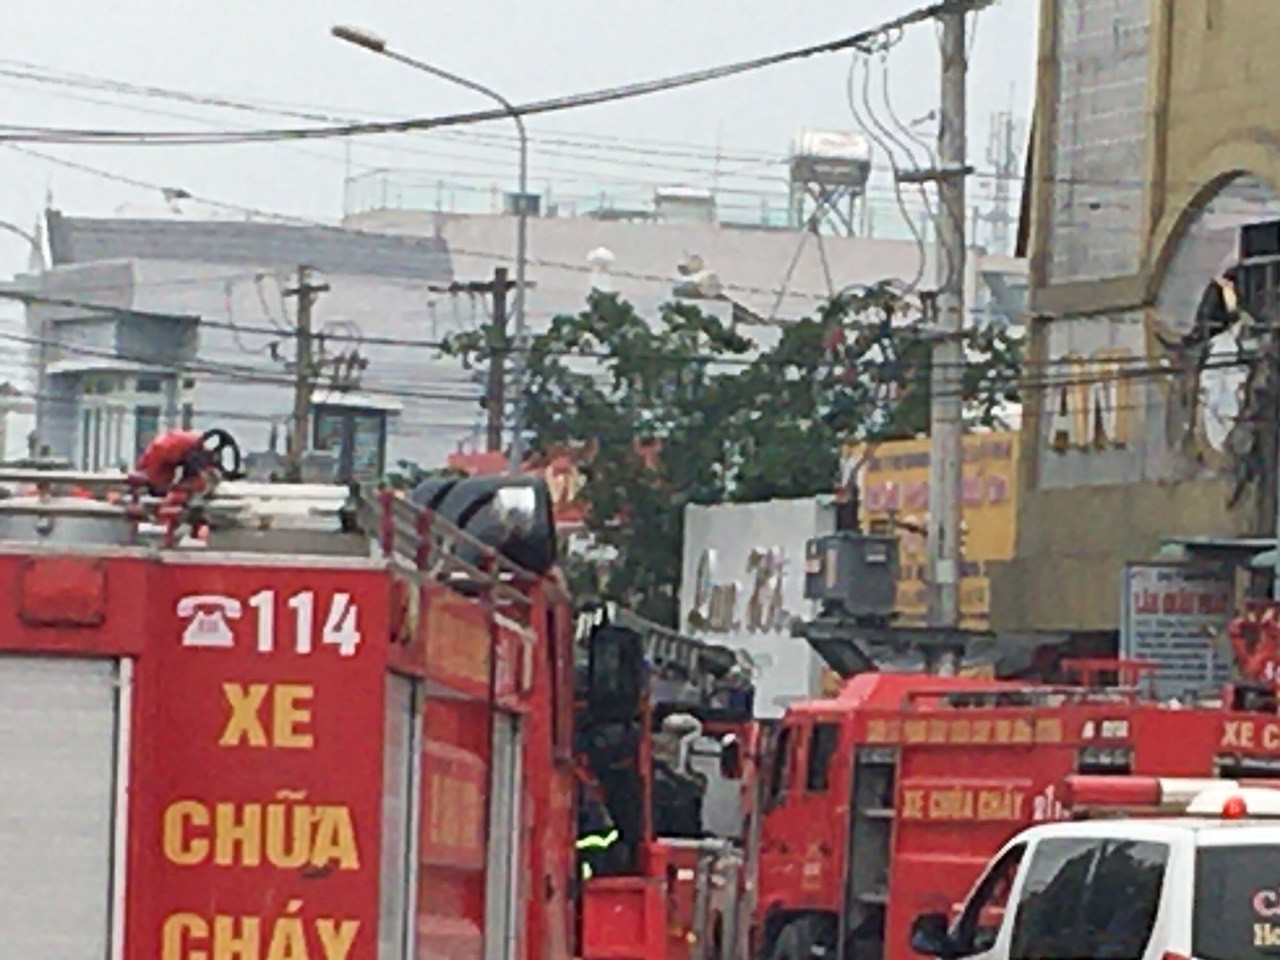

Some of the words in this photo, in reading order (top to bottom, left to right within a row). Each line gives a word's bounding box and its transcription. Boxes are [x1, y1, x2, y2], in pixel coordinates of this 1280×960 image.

[249, 590, 361, 656] 114
[219, 682, 314, 748] XE
[1221, 720, 1254, 747] XE
[162, 789, 360, 870] CHỮA
